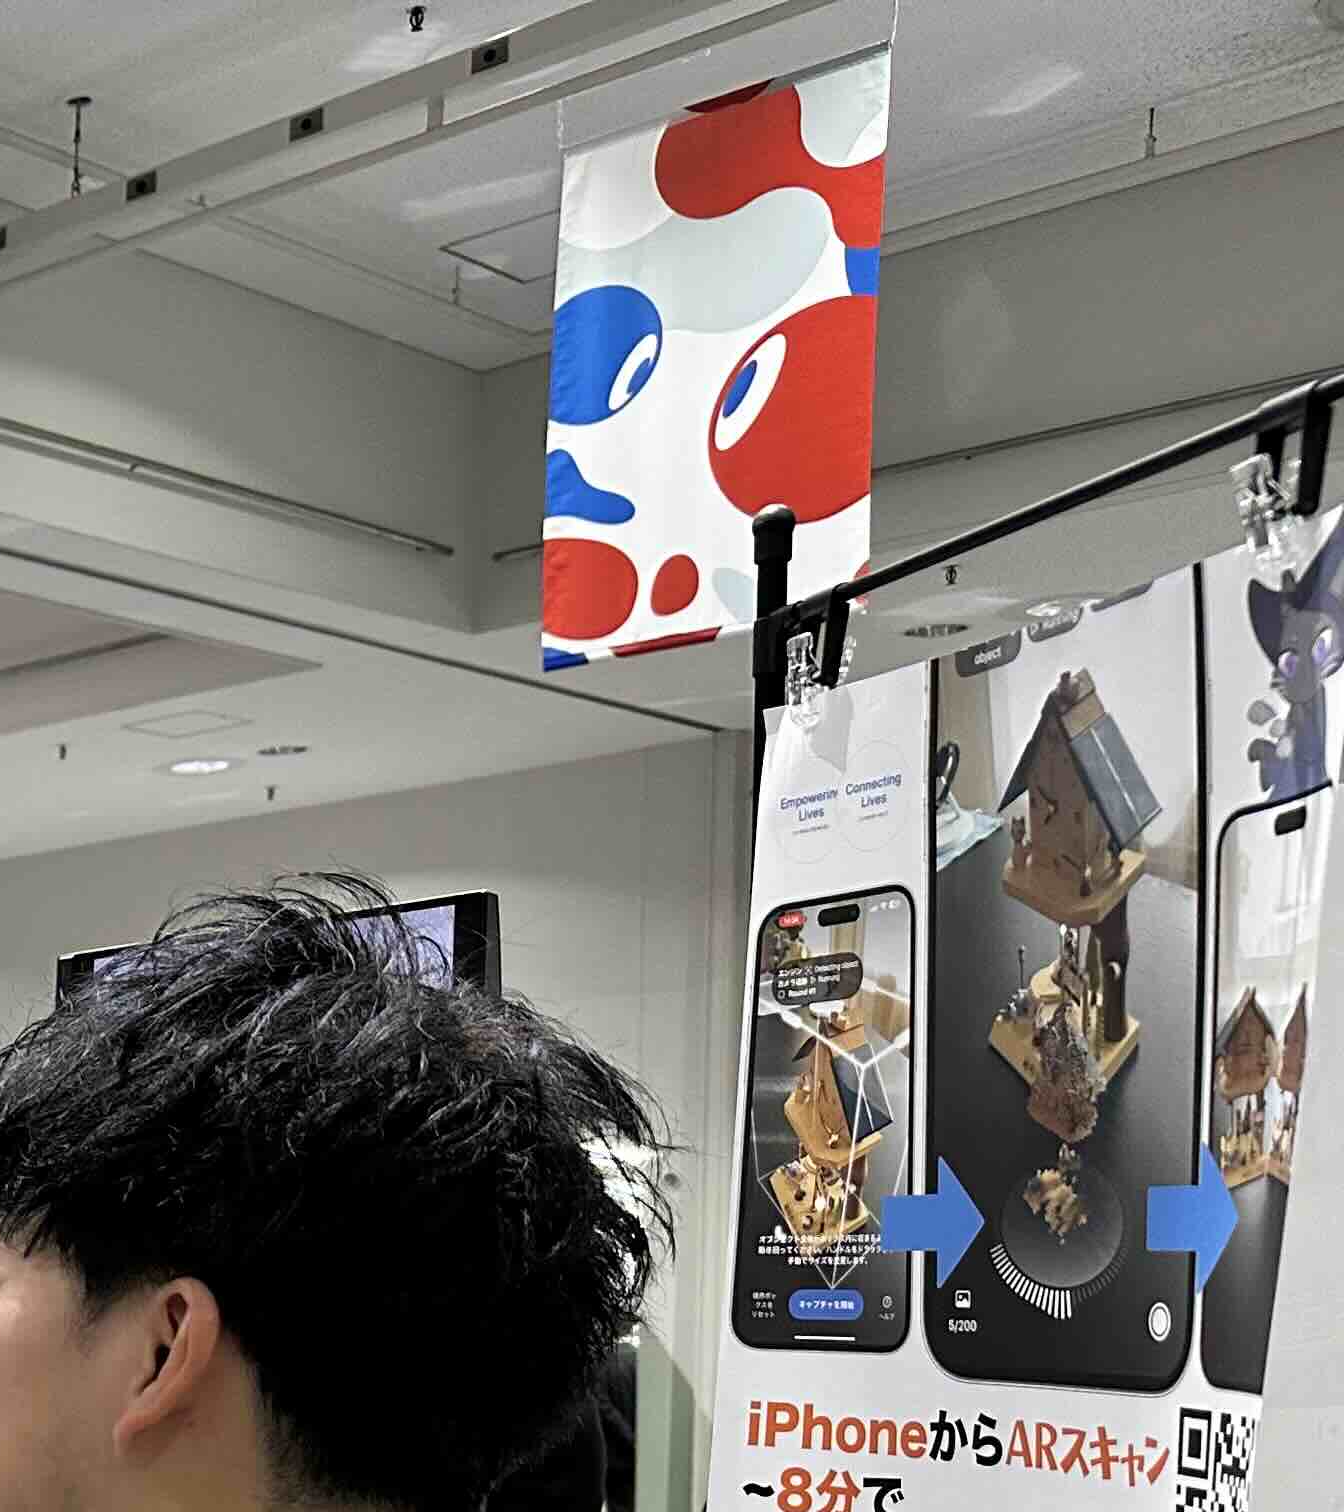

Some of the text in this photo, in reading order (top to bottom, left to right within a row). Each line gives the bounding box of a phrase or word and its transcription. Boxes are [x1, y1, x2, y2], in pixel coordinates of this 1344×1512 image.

[845, 773, 902, 796] Connecting
[780, 789, 839, 811] Empowerin
[861, 793, 887, 809] Lives
[798, 807, 825, 823] Lives
[746, 1401, 1171, 1488] iPhoneからARスキャン
